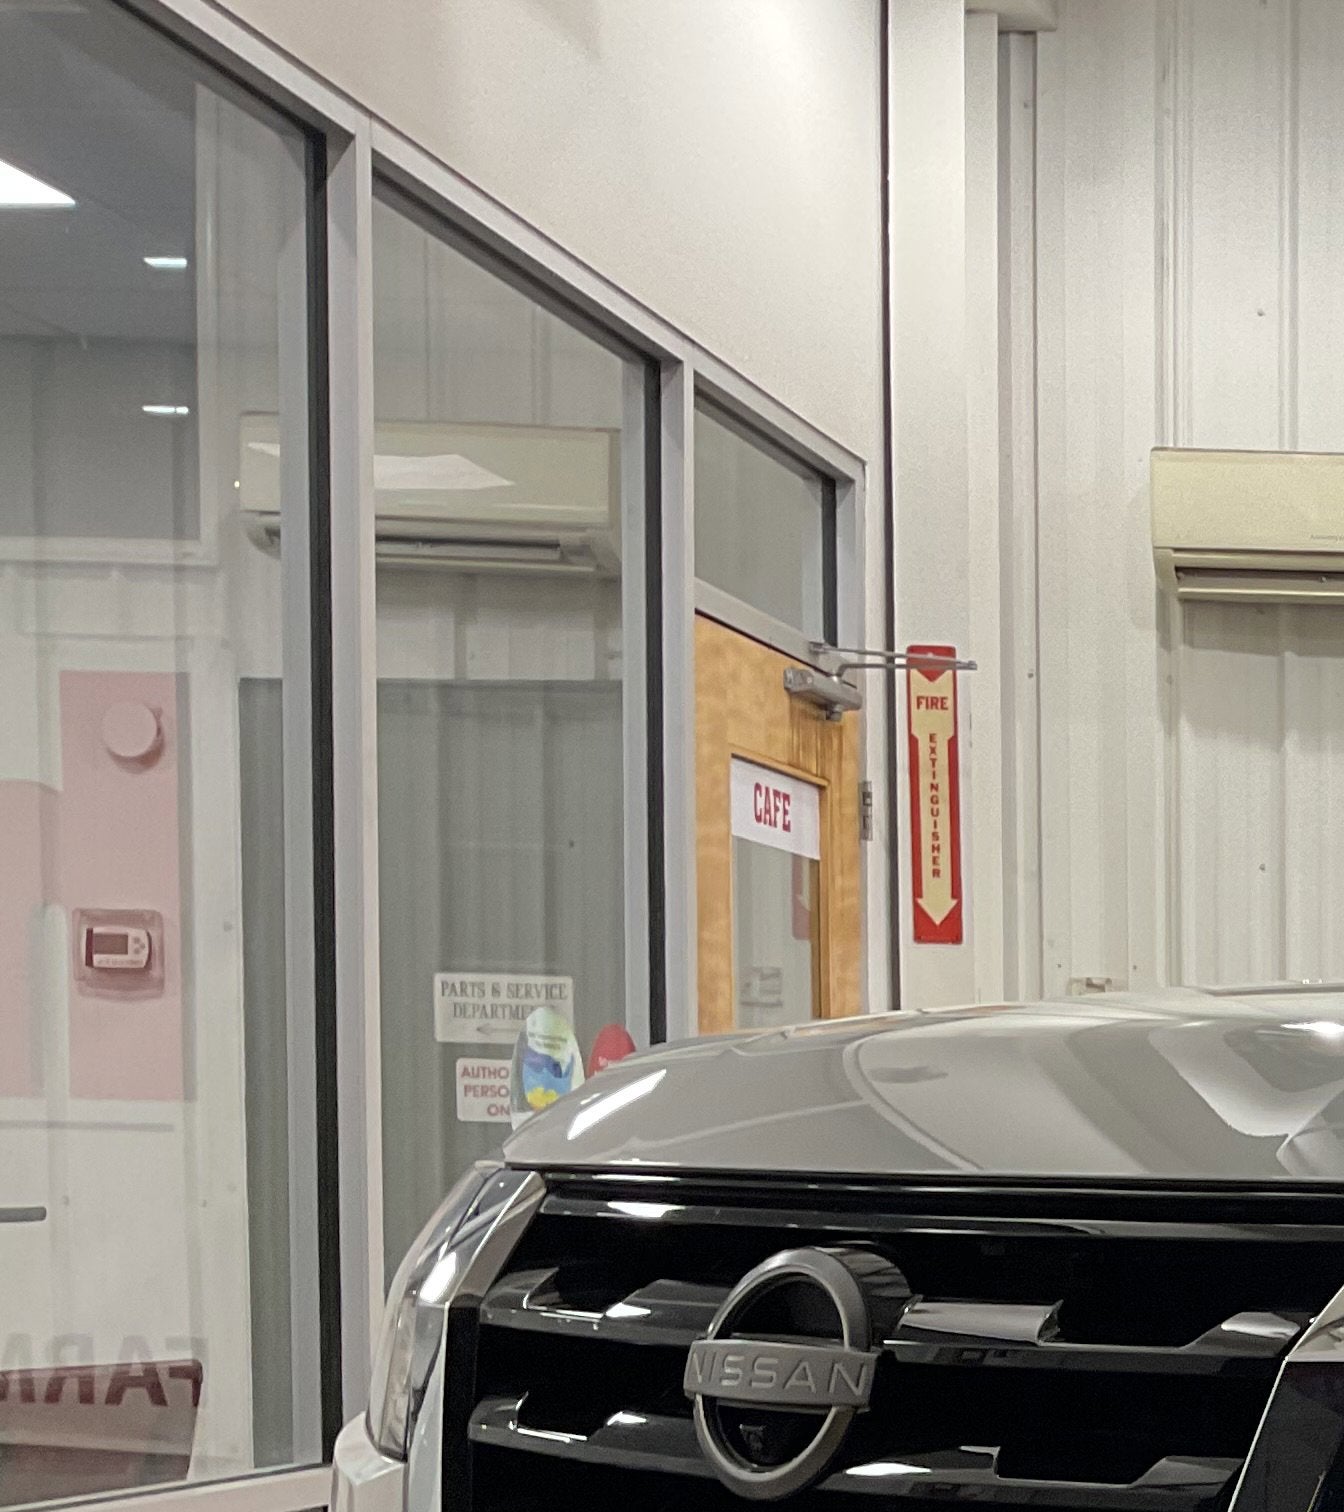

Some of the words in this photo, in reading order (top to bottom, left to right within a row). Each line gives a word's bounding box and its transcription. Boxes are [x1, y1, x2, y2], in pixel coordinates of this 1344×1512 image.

[916, 695, 949, 711] FIRE
[753, 782, 791, 833] CAFE
[928, 733, 942, 879] EXTINGUISHER
[440, 980, 485, 999] PARTS
[506, 983, 568, 1000] SERVICE
[453, 1003, 542, 1020] DEPARTME
[687, 1350, 869, 1398] NISSAN
